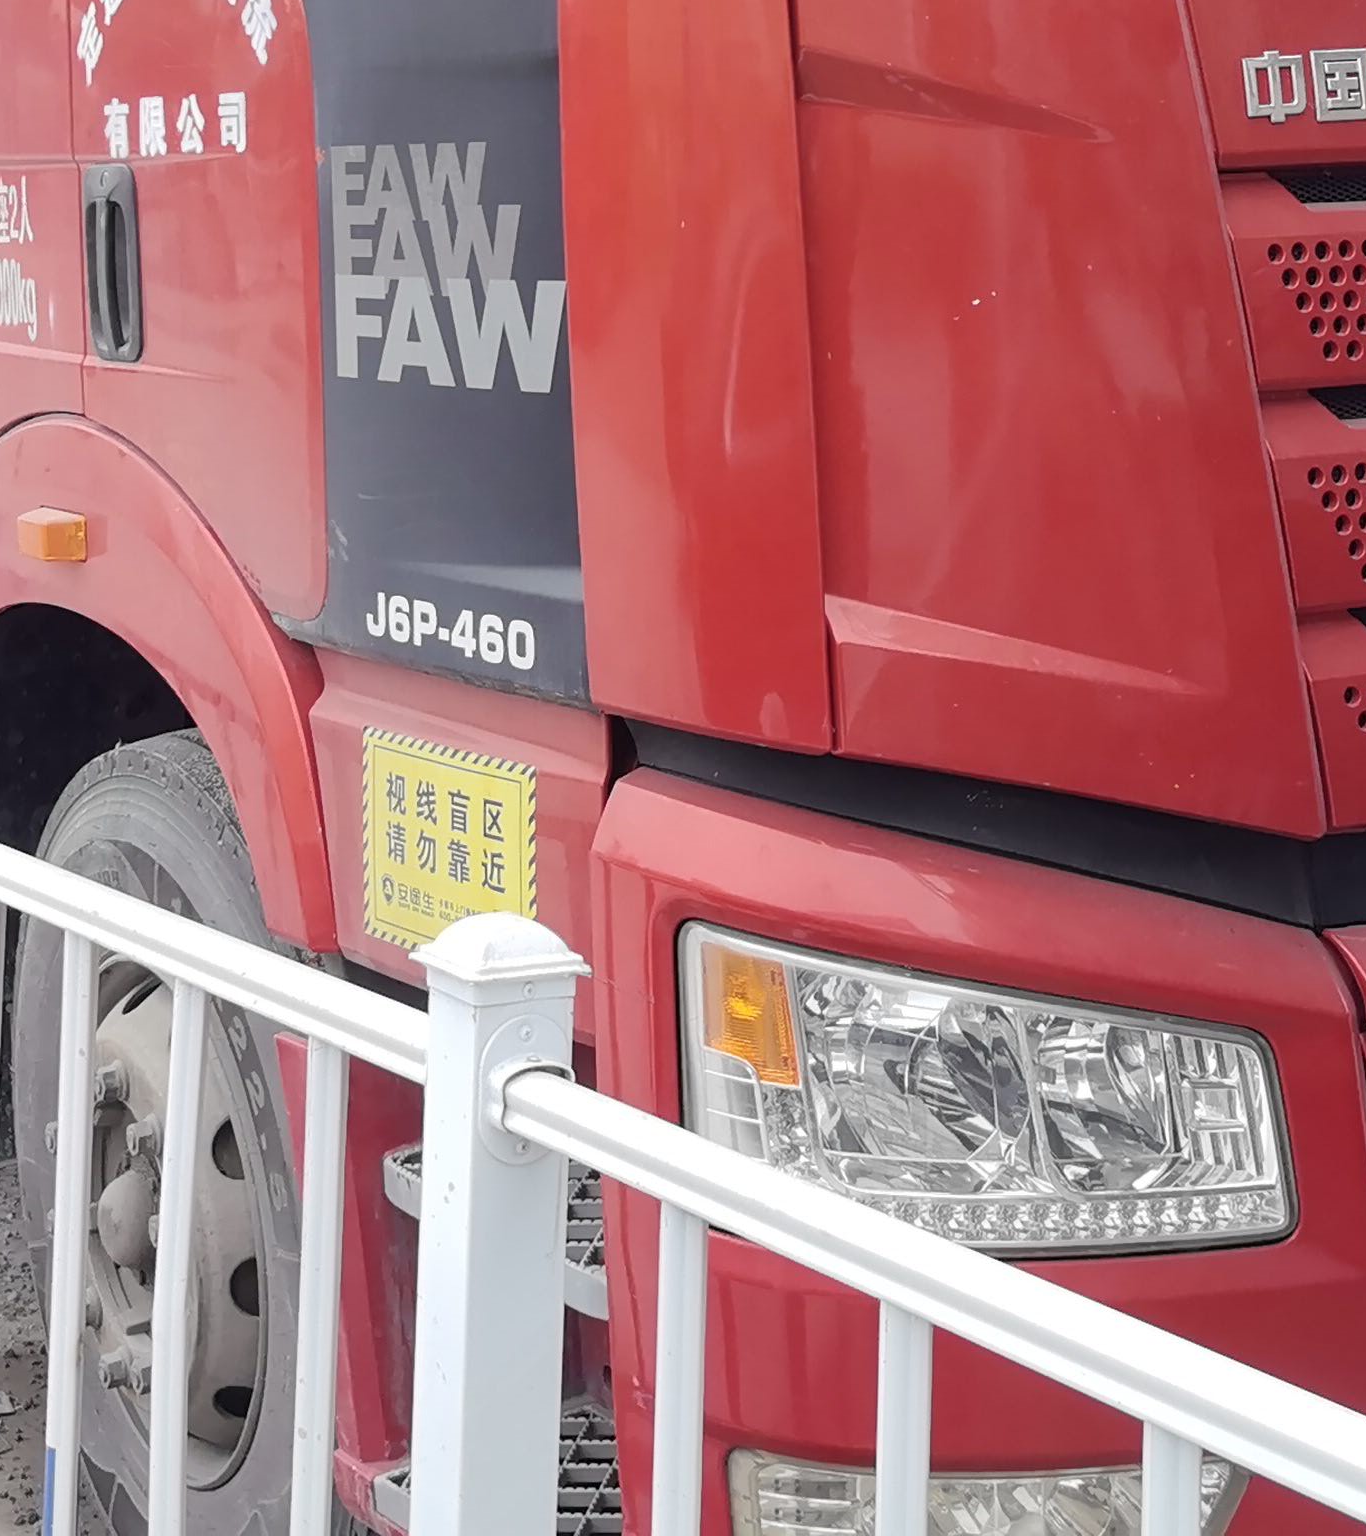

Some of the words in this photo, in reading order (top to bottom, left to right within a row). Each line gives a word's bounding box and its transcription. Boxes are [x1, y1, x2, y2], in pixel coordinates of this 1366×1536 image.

[104, 91, 247, 159] 有限公司
[335, 274, 567, 393] FAW
[366, 591, 536, 671] J6P-460
[386, 772, 505, 843] 视线盲区
[385, 821, 507, 894] 请勿靠近
